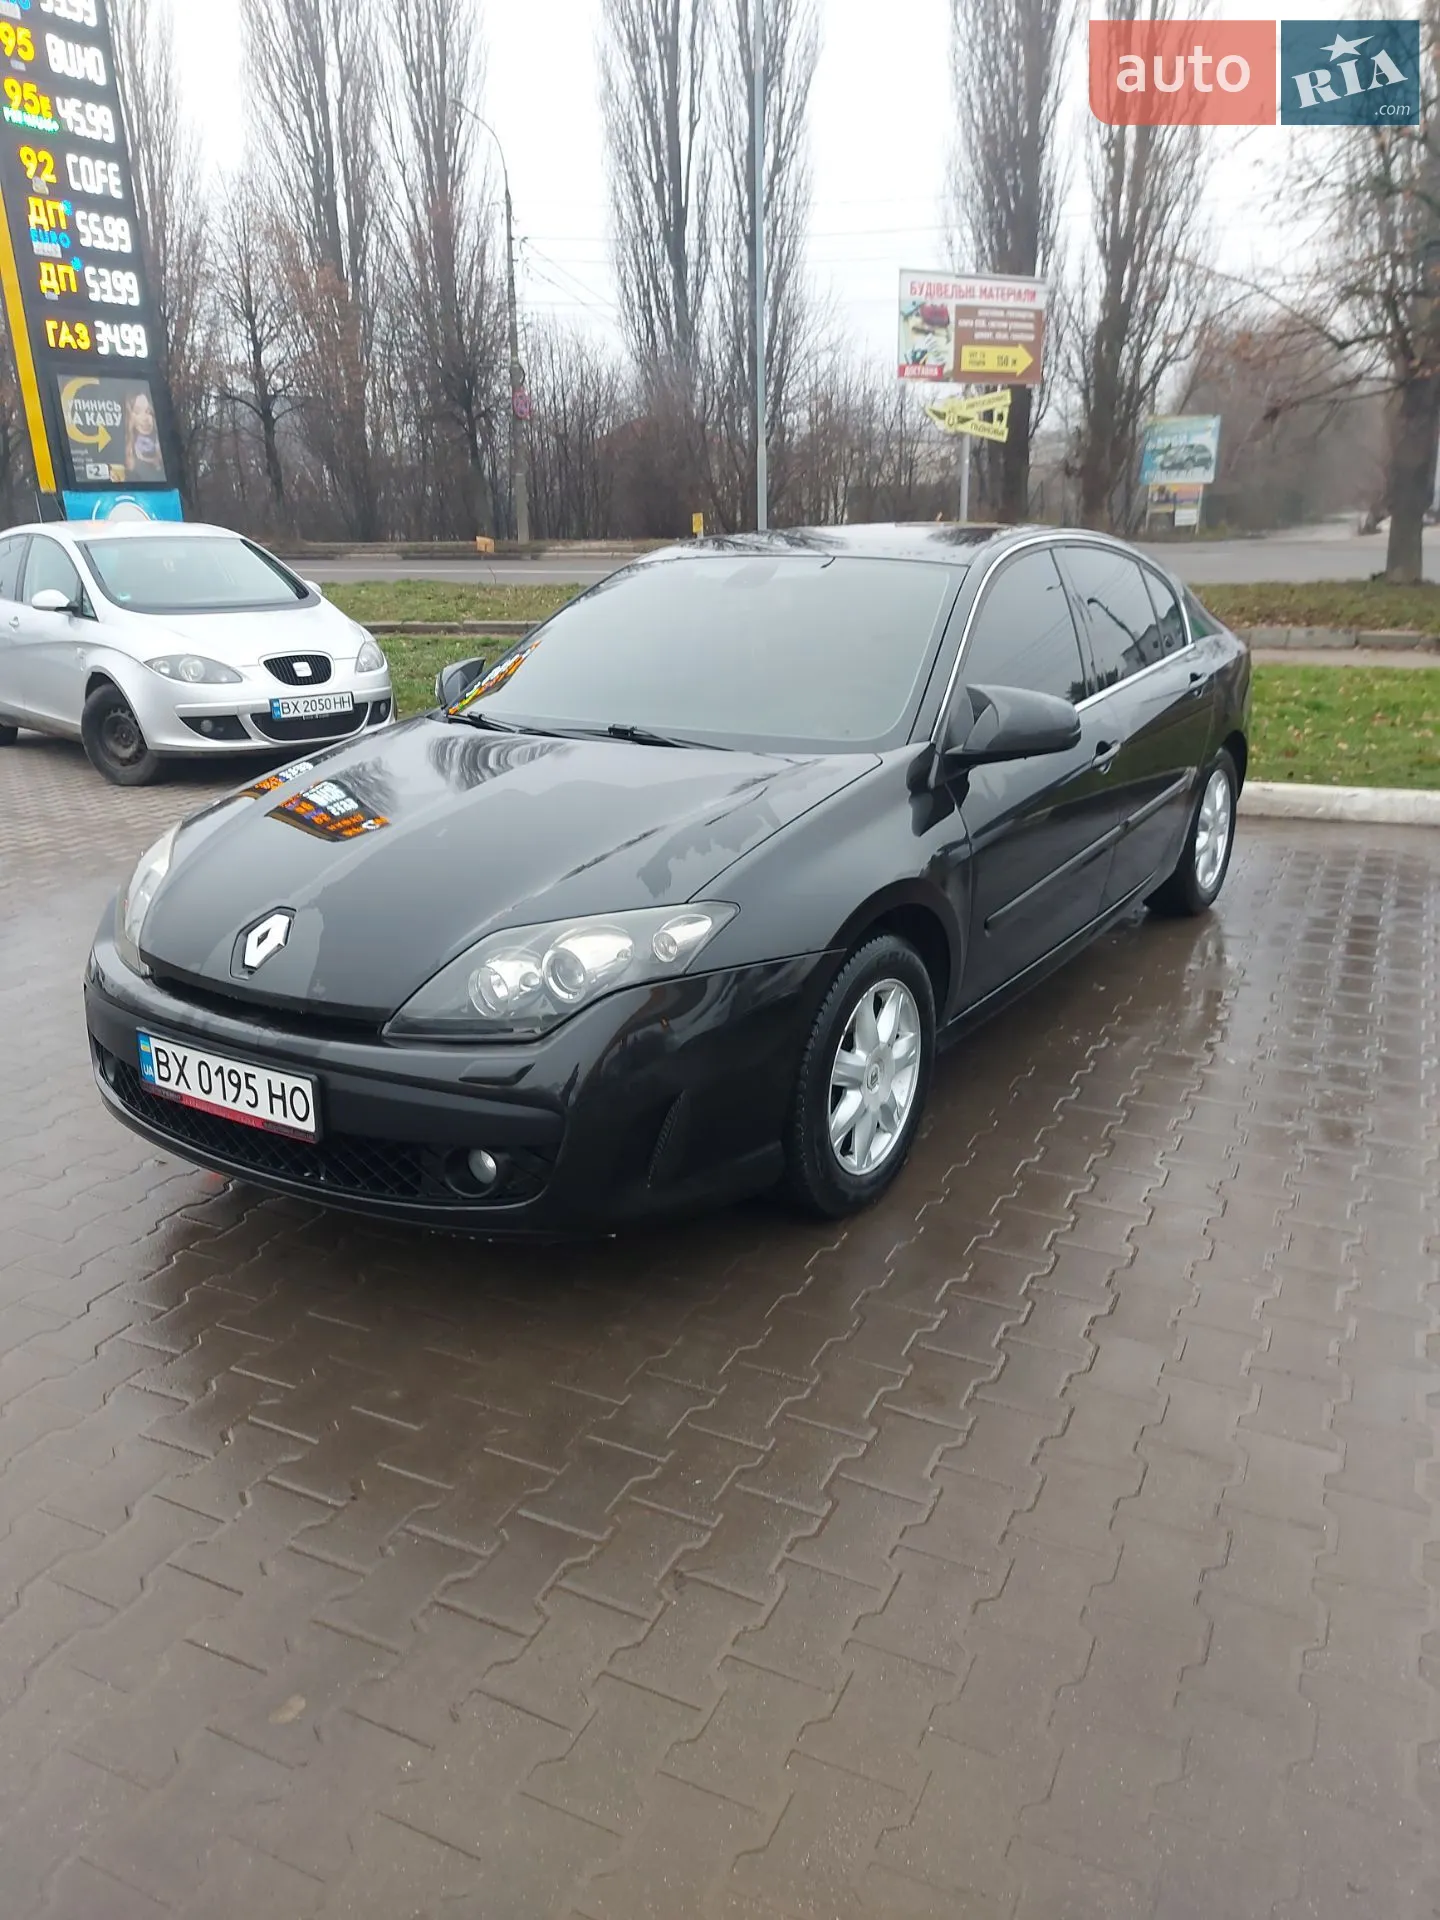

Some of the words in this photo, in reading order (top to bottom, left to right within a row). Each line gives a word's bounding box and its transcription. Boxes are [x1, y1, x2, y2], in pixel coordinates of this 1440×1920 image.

[0, 22, 34, 61] 95
[19, 146, 57, 183] 92
[28, 196, 67, 231] ДП
[39, 262, 77, 295] ДП
[910, 281, 975, 299] БУДІВЕЛЬНІ
[979, 285, 1037, 303] МАТЕРІАЛИ
[45, 319, 91, 350] ГАЗ
[85, 411, 122, 428] КАВУ
[281, 702, 301, 716] BX
[302, 697, 331, 713] 2050
[333, 695, 351, 710] HH
[154, 1047, 191, 1090] BX
[197, 1060, 259, 1108] 0195
[266, 1078, 310, 1123] HO
